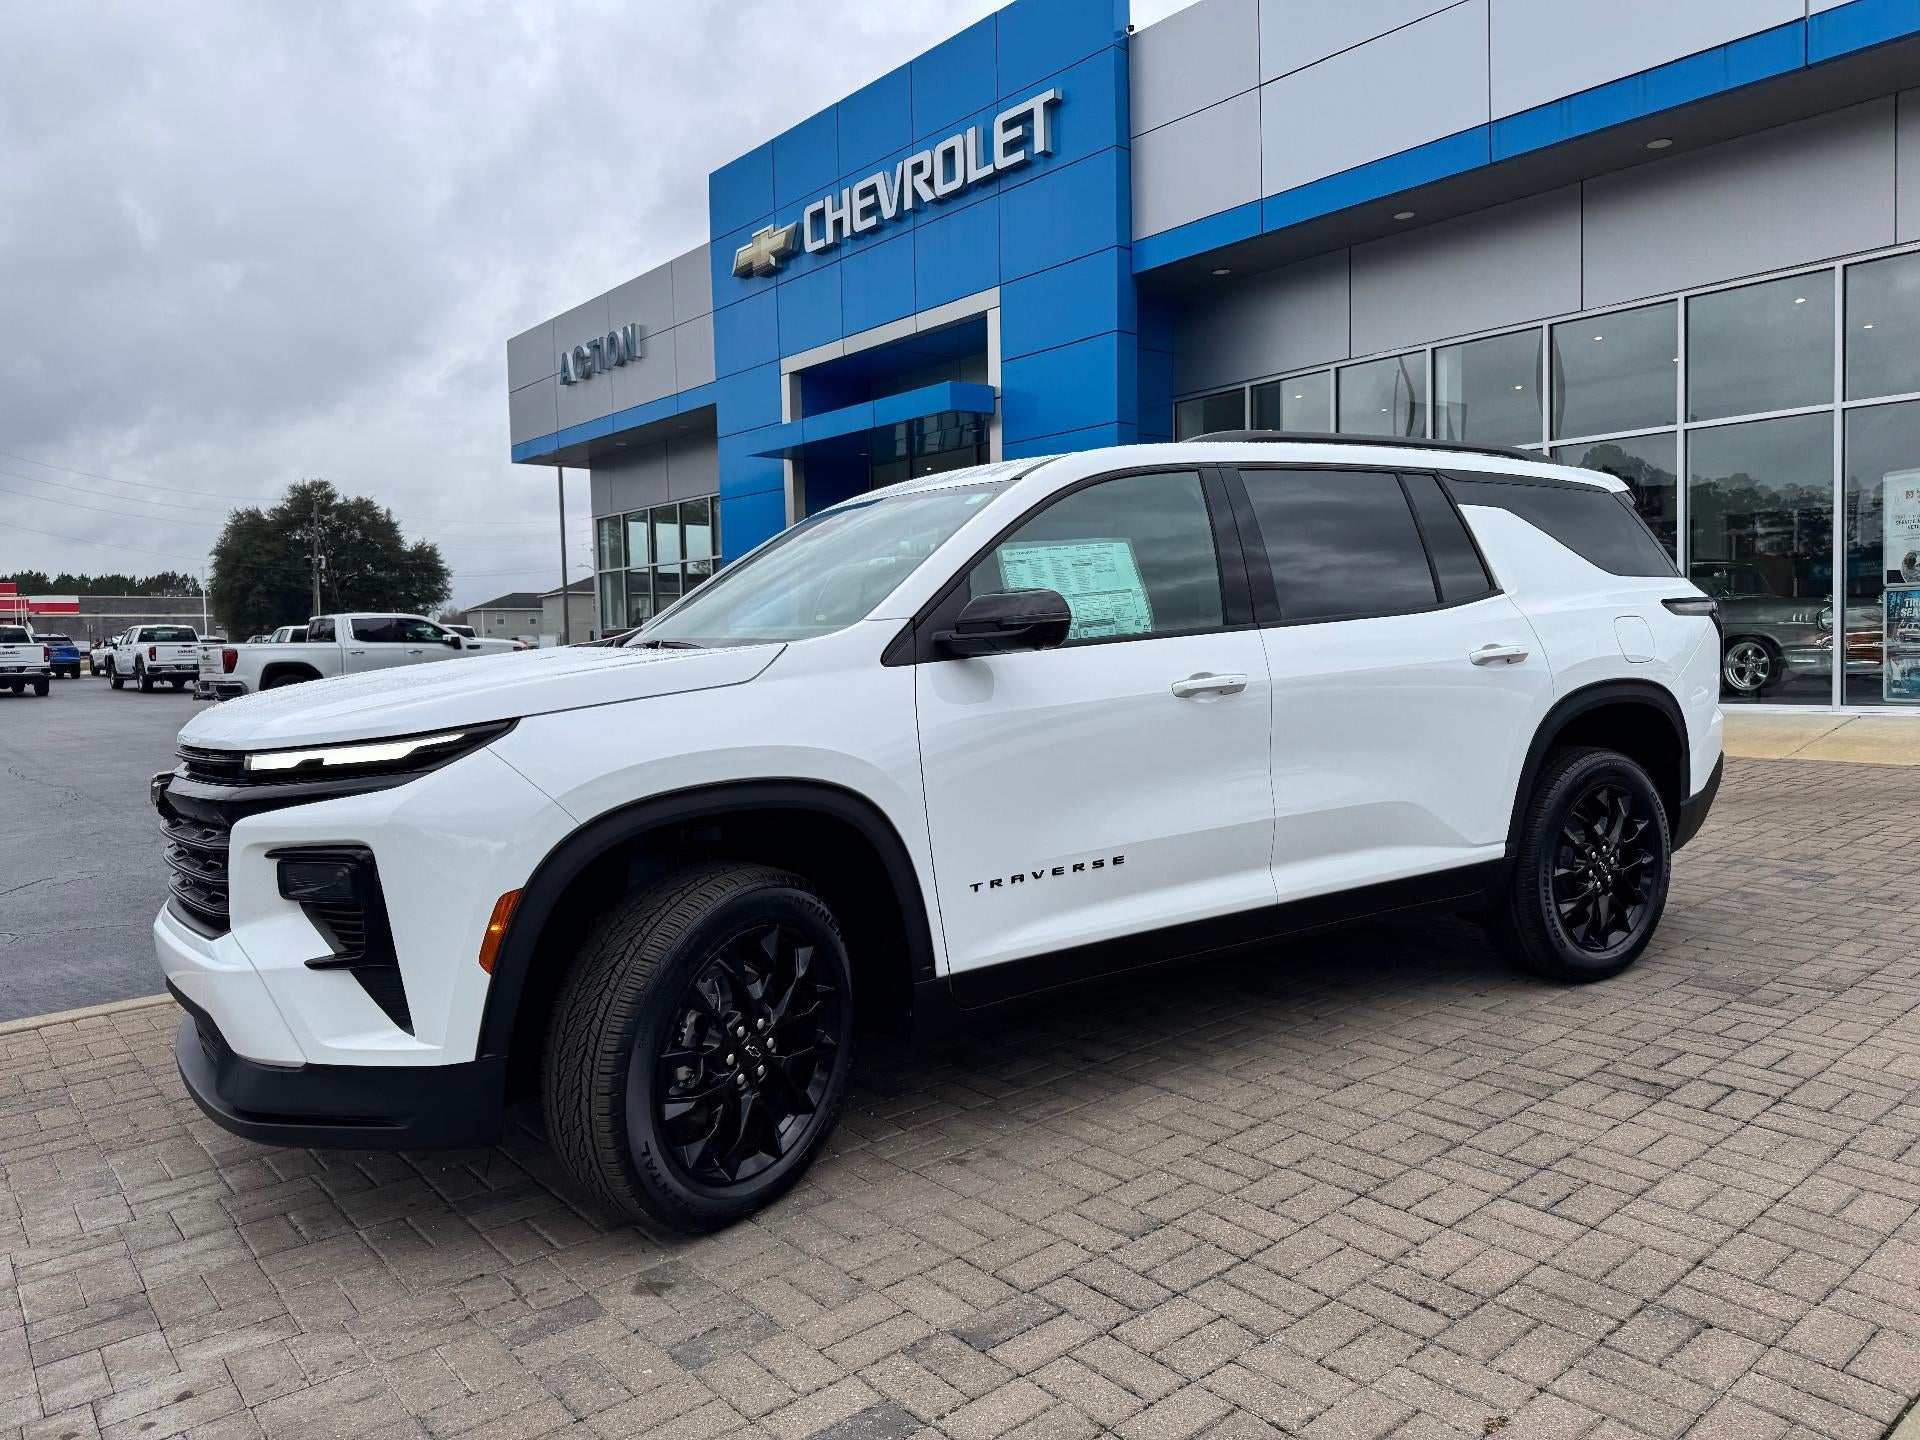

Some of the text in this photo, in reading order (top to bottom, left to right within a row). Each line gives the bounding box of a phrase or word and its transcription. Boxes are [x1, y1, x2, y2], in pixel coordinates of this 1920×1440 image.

[803, 87, 1063, 254] CHEVROLET
[560, 322, 641, 386] ACTION
[1900, 607, 1920, 618] SEA
[969, 855, 1125, 893] TRAVERSE
